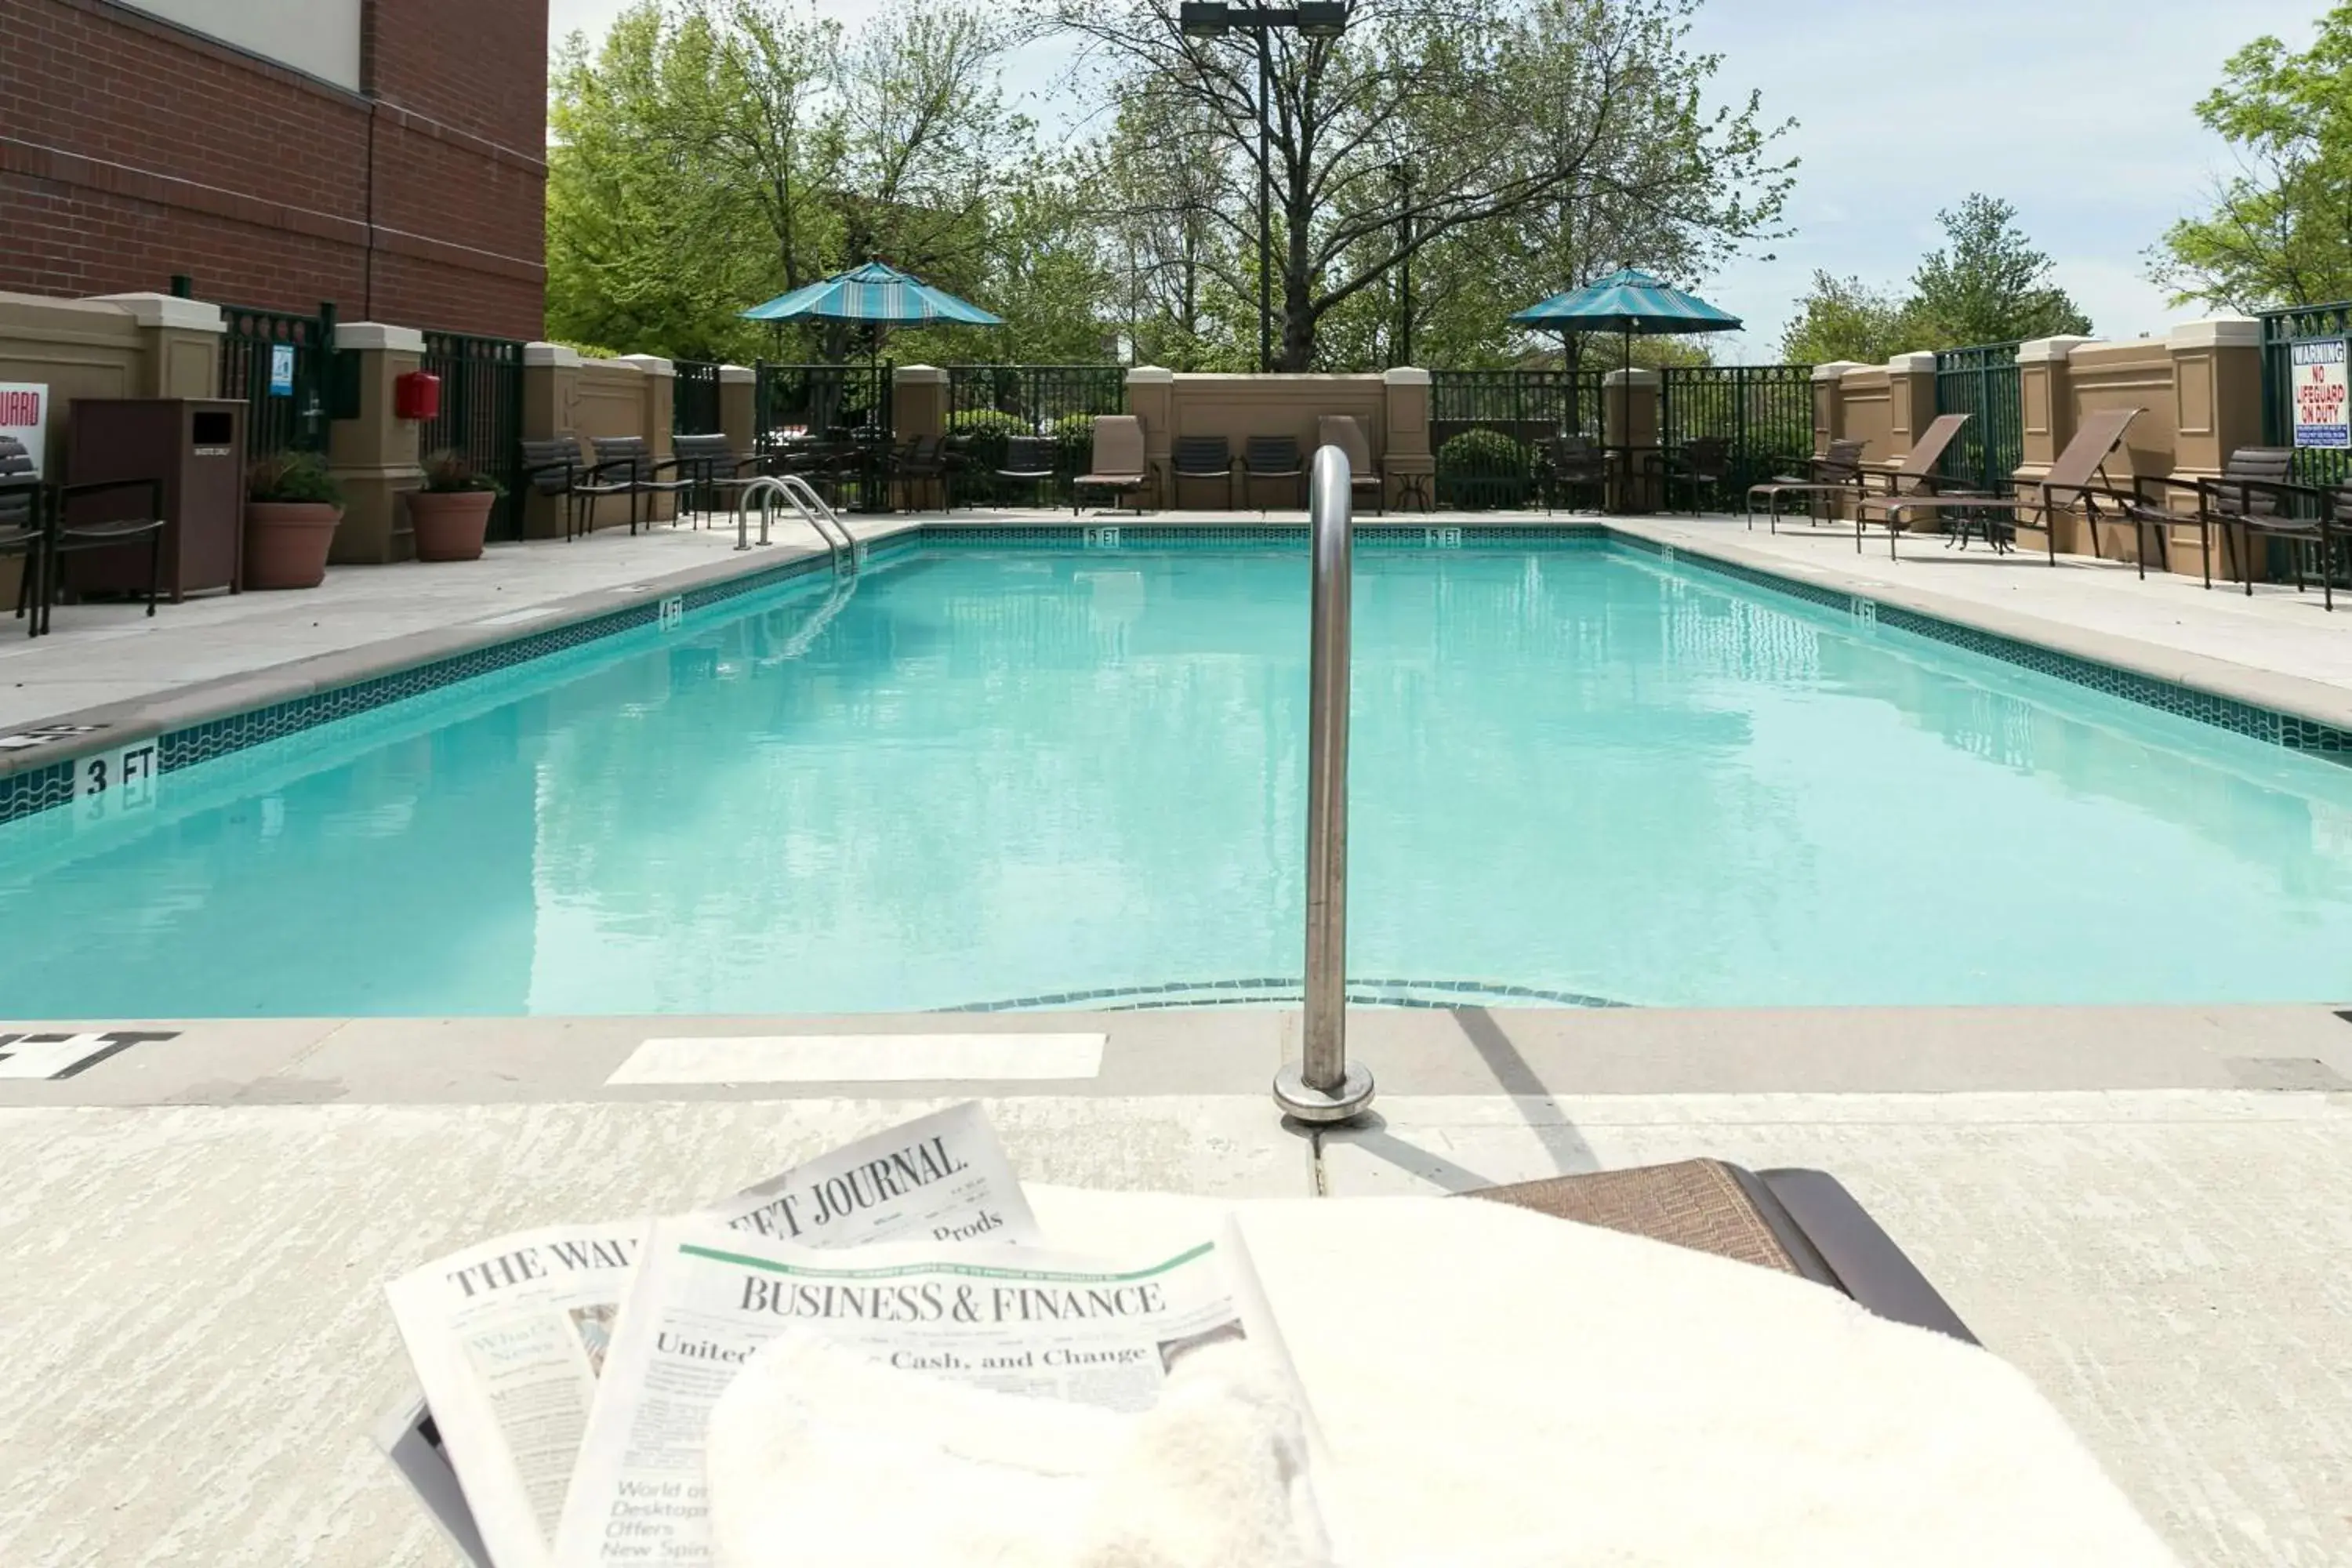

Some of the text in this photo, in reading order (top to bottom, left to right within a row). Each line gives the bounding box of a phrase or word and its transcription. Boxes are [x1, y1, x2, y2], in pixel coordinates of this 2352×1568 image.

[2295, 342, 2343, 364] WARNING
[2311, 365, 2325, 383] NO
[2296, 383, 2345, 404] LIFEGUARD
[2301, 404, 2339, 424] ON DUTY
[1103, 529, 1117, 541] FT
[86, 746, 154, 796] 3 FT
[812, 1136, 969, 1226] JOURNAL.
[446, 1238, 639, 1298] THE WAL
[739, 1276, 1167, 1324] BUSINESS & FINANCE
[890, 1350, 971, 1370] Cash,
[981, 1352, 1033, 1369] and
[1043, 1347, 1149, 1367] Change
[618, 1480, 682, 1498] World
[601, 1541, 653, 1559] New
